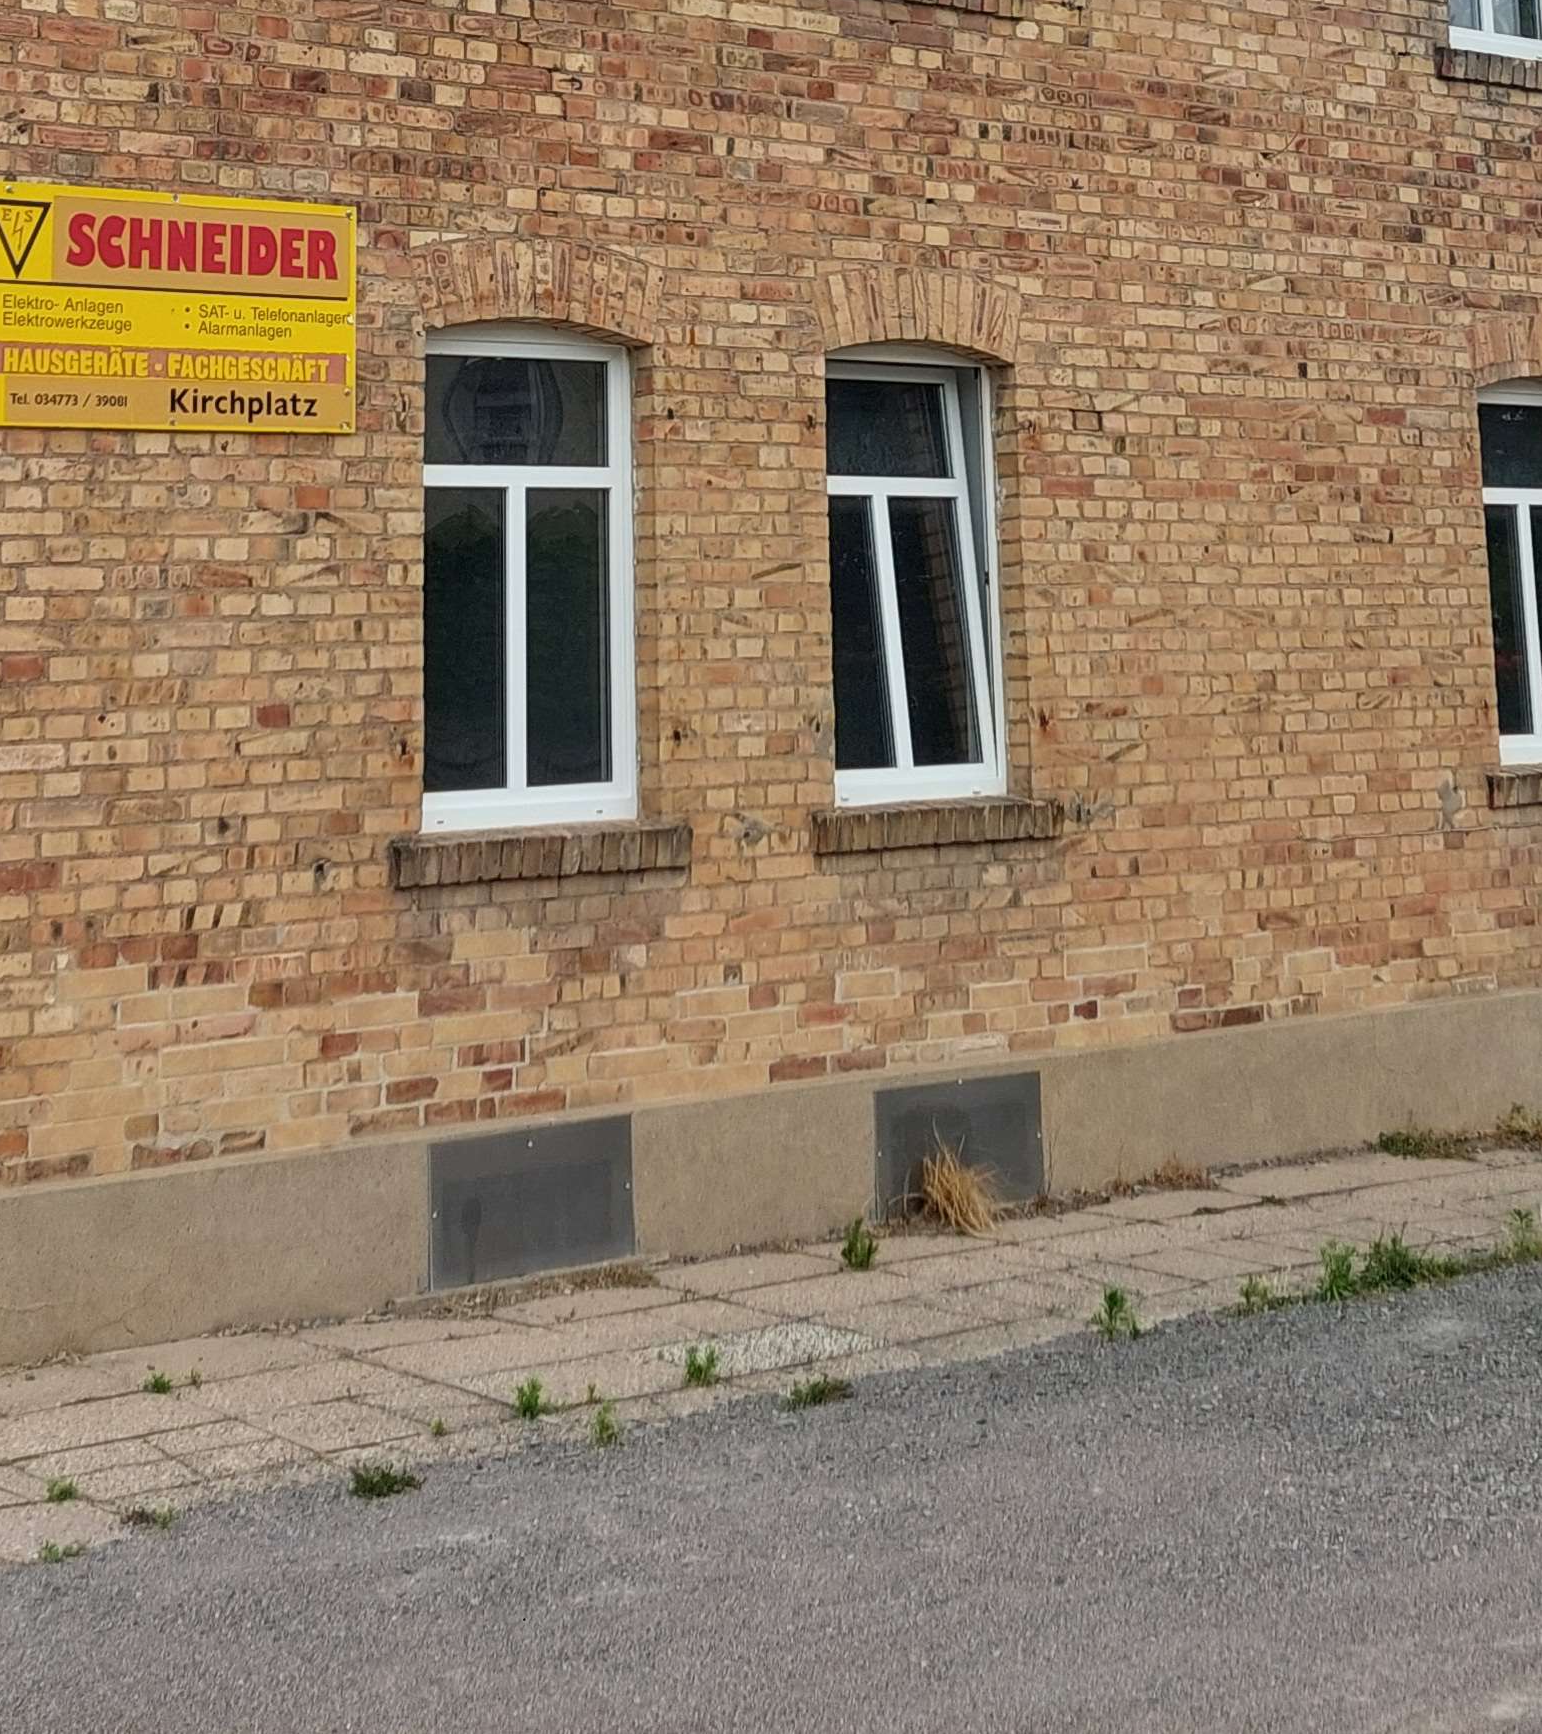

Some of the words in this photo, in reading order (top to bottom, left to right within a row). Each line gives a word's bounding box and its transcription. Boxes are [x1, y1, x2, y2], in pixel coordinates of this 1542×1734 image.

[65, 212, 339, 281] SCHNEIDER
[2, 293, 60, 311] Elektro-
[63, 297, 124, 317] Anlagen
[198, 303, 229, 319] SAT-
[2, 311, 132, 334] Elektrowerkzeuge
[198, 320, 292, 341] Alarmanlagen
[2, 346, 150, 378] HAUSGERÄTE
[167, 352, 330, 383] FACHGESCHÄFT
[10, 392, 30, 406] Tel.
[34, 393, 79, 407] 034773
[95, 394, 128, 408] 39081
[169, 387, 319, 424] Kirchplatz
